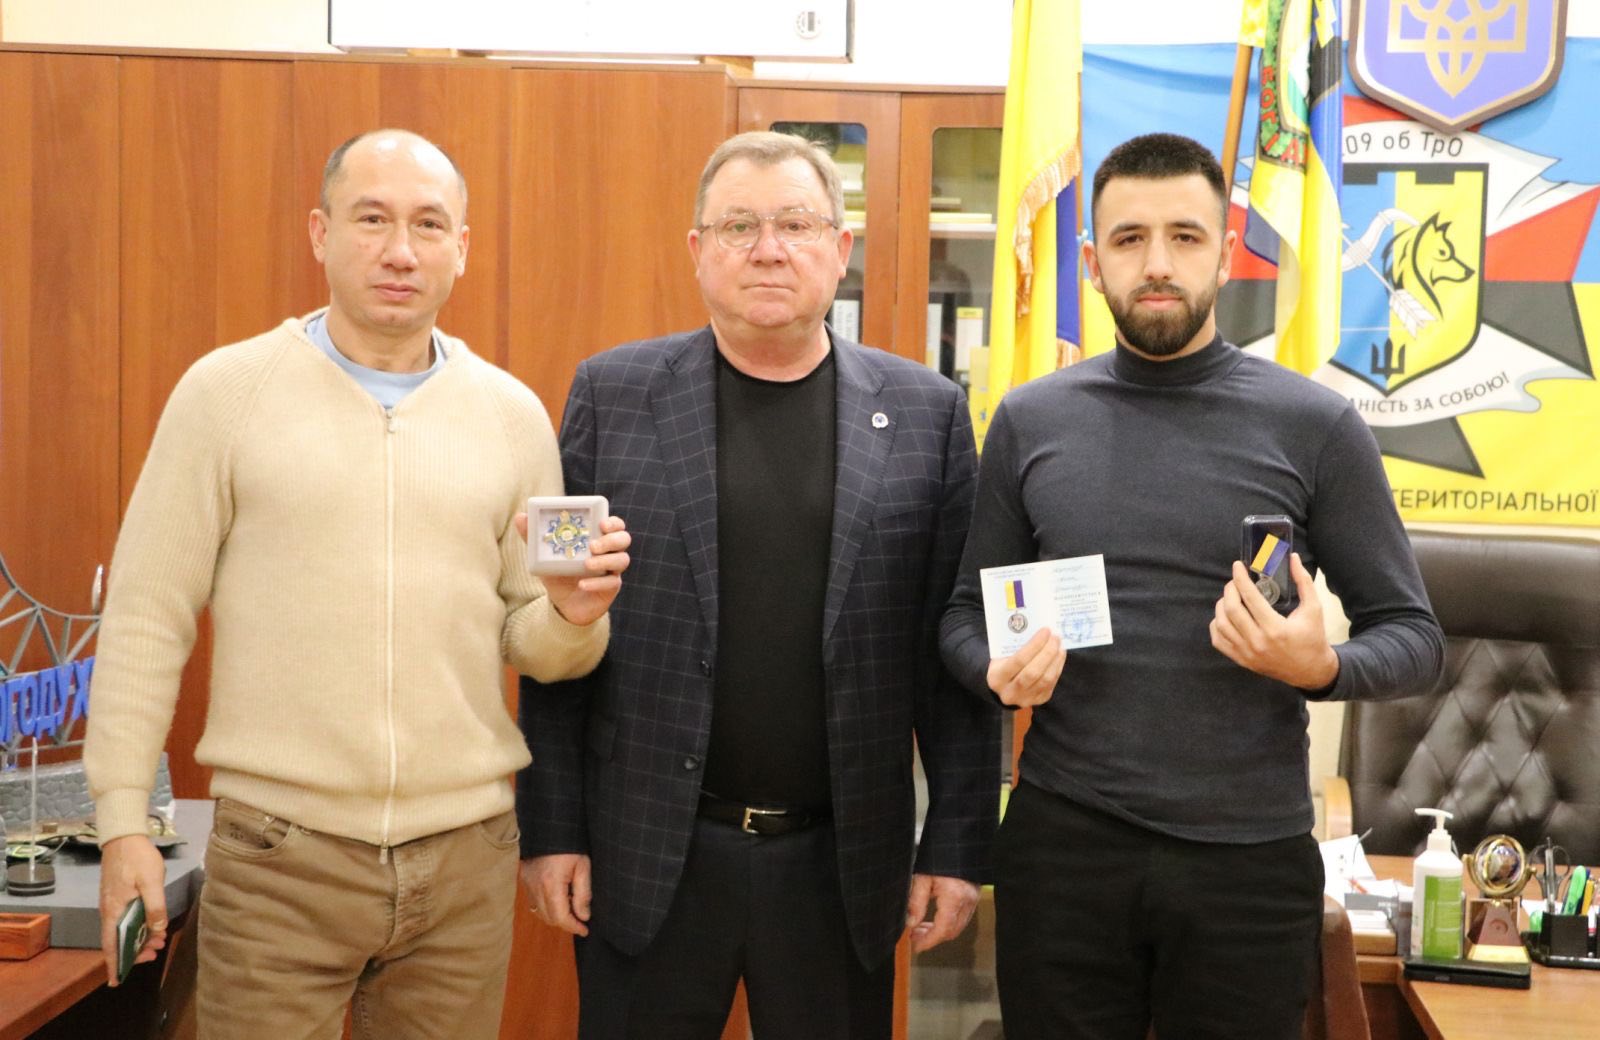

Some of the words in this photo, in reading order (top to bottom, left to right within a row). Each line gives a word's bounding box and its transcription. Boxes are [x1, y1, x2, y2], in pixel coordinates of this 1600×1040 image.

[1341, 132, 1373, 156] 09
[1382, 130, 1411, 151] об
[1420, 131, 1464, 158] ТрО
[1413, 397, 1435, 413] ЗА
